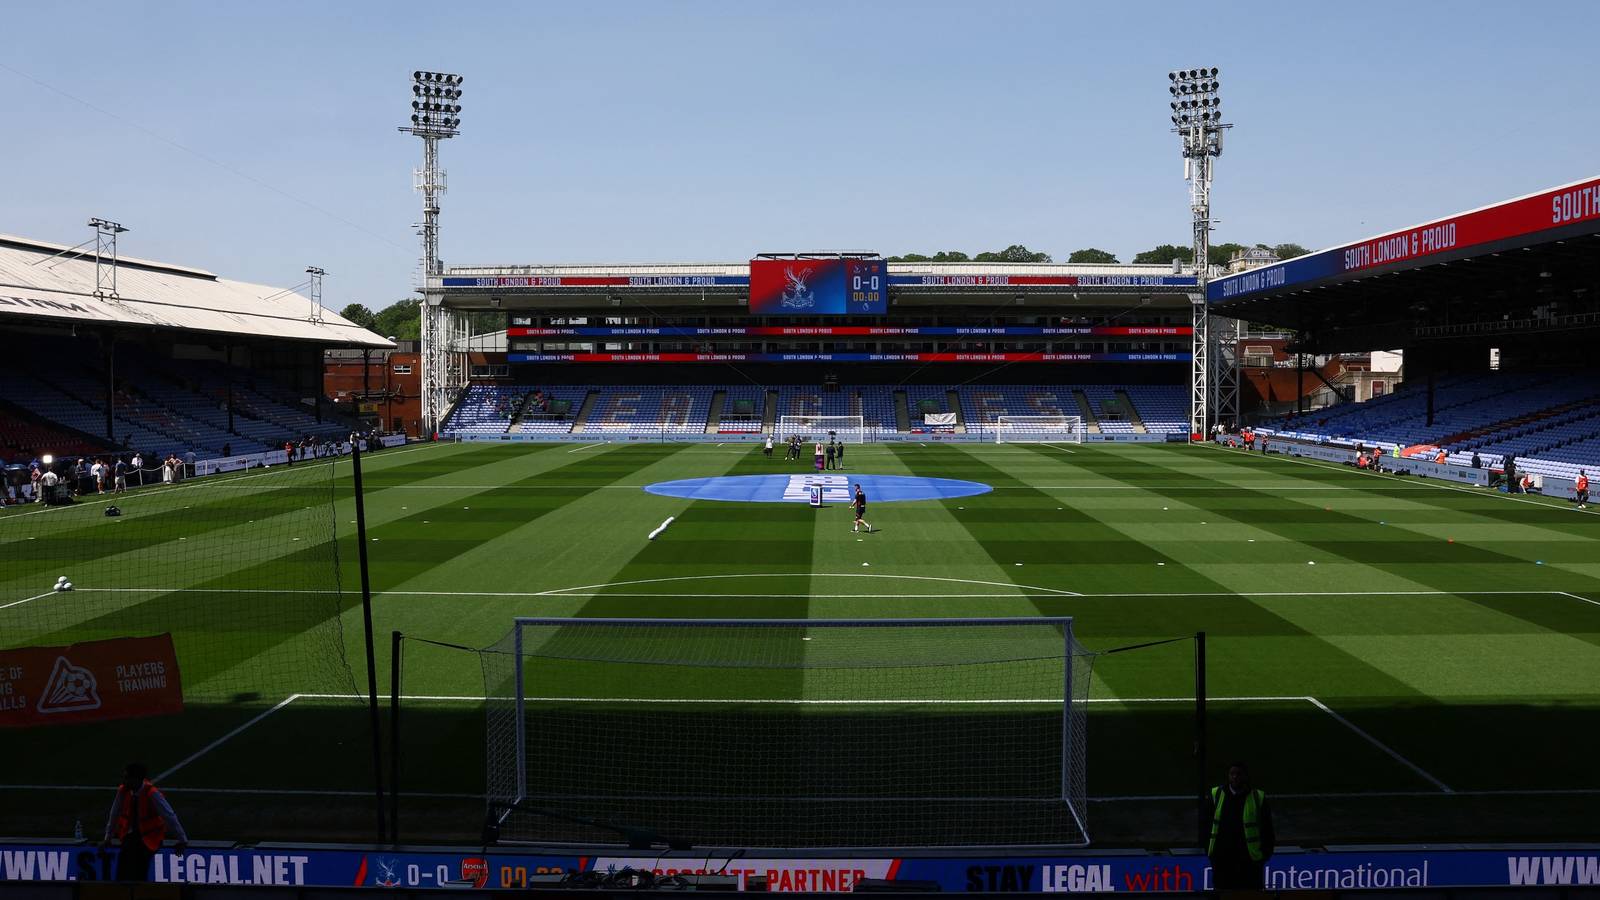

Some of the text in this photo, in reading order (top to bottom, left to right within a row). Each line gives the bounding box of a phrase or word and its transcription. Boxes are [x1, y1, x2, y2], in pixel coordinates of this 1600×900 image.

[1552, 185, 1600, 224] SOUTH
[1345, 223, 1456, 270] SOUTH LONDON & PROUD
[477, 278, 498, 286] SOUTH
[500, 278, 529, 286] LONDON
[538, 278, 561, 286] PROUD
[629, 277, 651, 285] SOUTH
[653, 277, 684, 285] LONDON
[692, 277, 715, 285] PROUD
[853, 275, 879, 290] 0-0
[922, 276, 944, 284] SOUTH
[947, 276, 976, 284] LONDON
[986, 276, 1009, 284] PROUD
[1077, 277, 1099, 285] SOUTH
[1103, 277, 1130, 285] LONDON
[1140, 277, 1164, 285] PROUD
[1223, 279, 1238, 297] SOUTH
[1239, 273, 1260, 293] LONDON
[1266, 267, 1285, 287] PROUD
[853, 292, 879, 302] 00:00
[9, 666, 23, 680] OF
[115, 661, 165, 680] PLAYERS
[116, 674, 167, 693] TRAINING
[966, 865, 1034, 892] STAY
[1042, 864, 1115, 892] LEGAL
[1124, 863, 1194, 892] with
[1265, 859, 1429, 889] International
